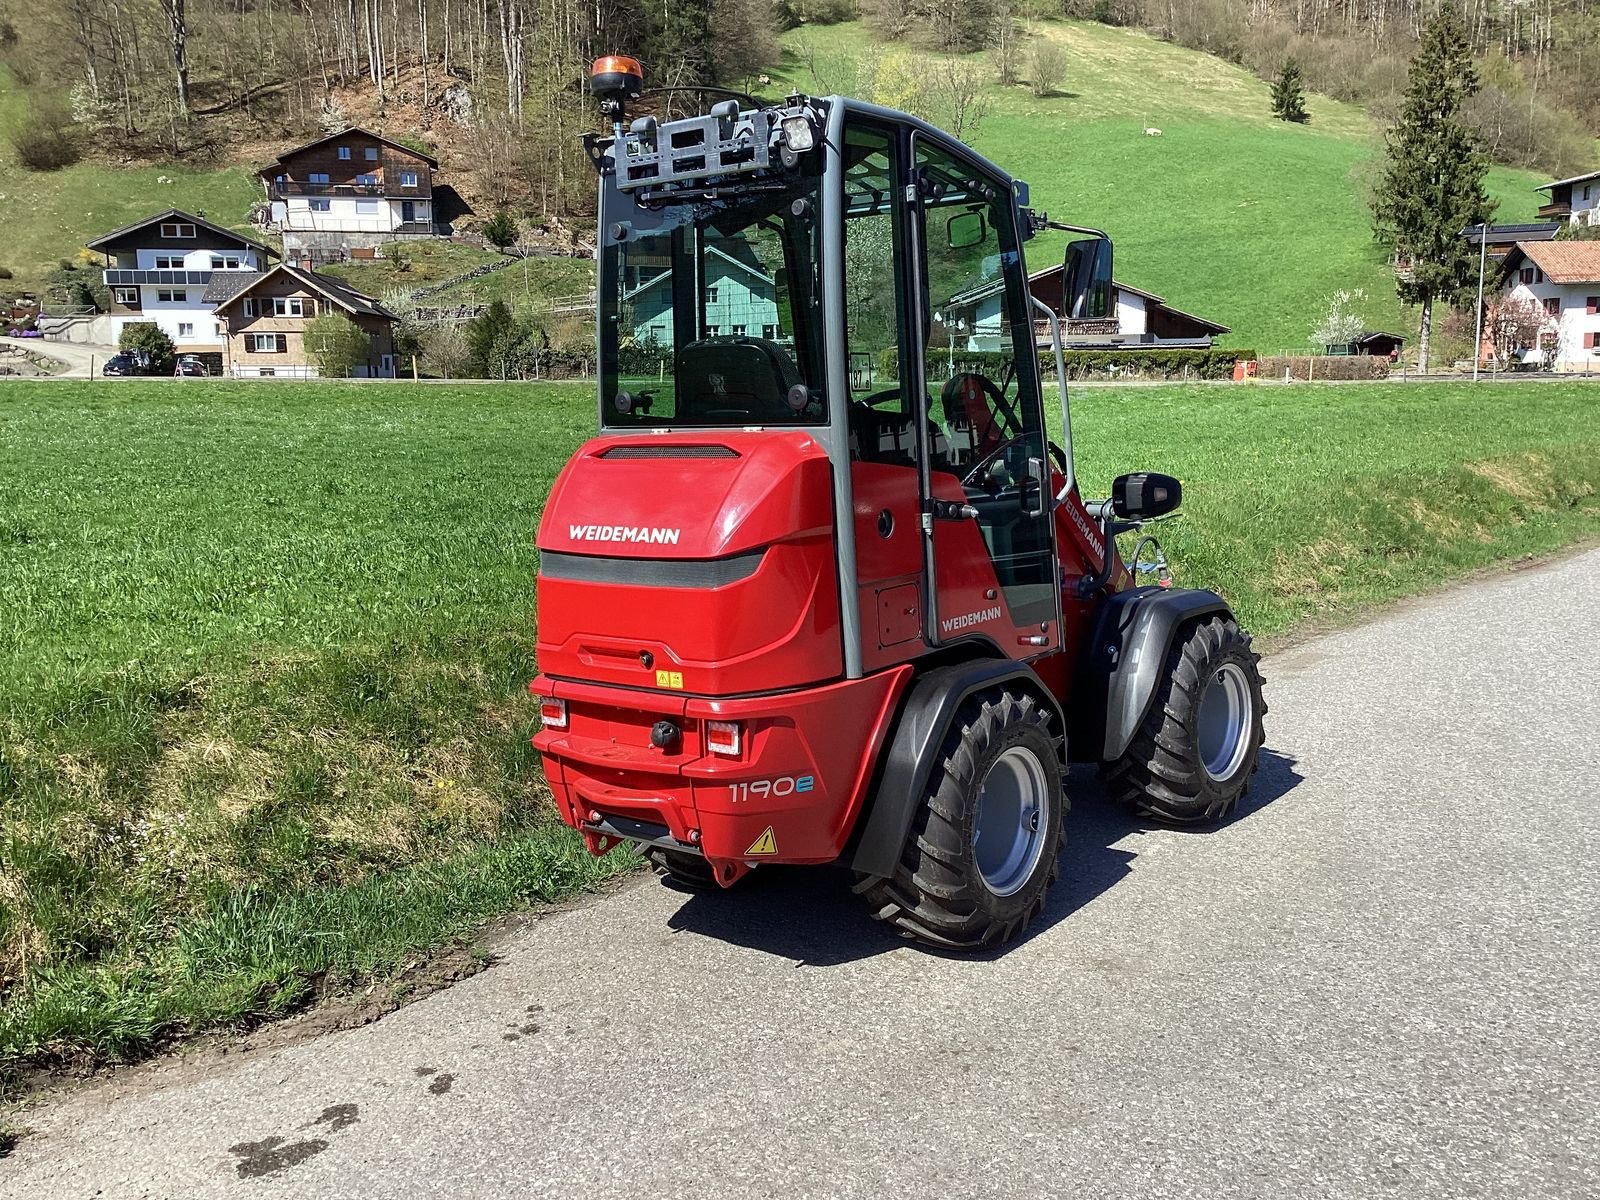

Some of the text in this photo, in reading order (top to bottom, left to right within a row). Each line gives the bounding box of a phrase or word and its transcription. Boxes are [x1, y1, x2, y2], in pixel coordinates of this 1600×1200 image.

[853, 369, 862, 389] 87
[569, 524, 681, 545] WEIDEMANN
[942, 606, 1001, 632] WEIDEMANN
[728, 775, 814, 803] 1190e
